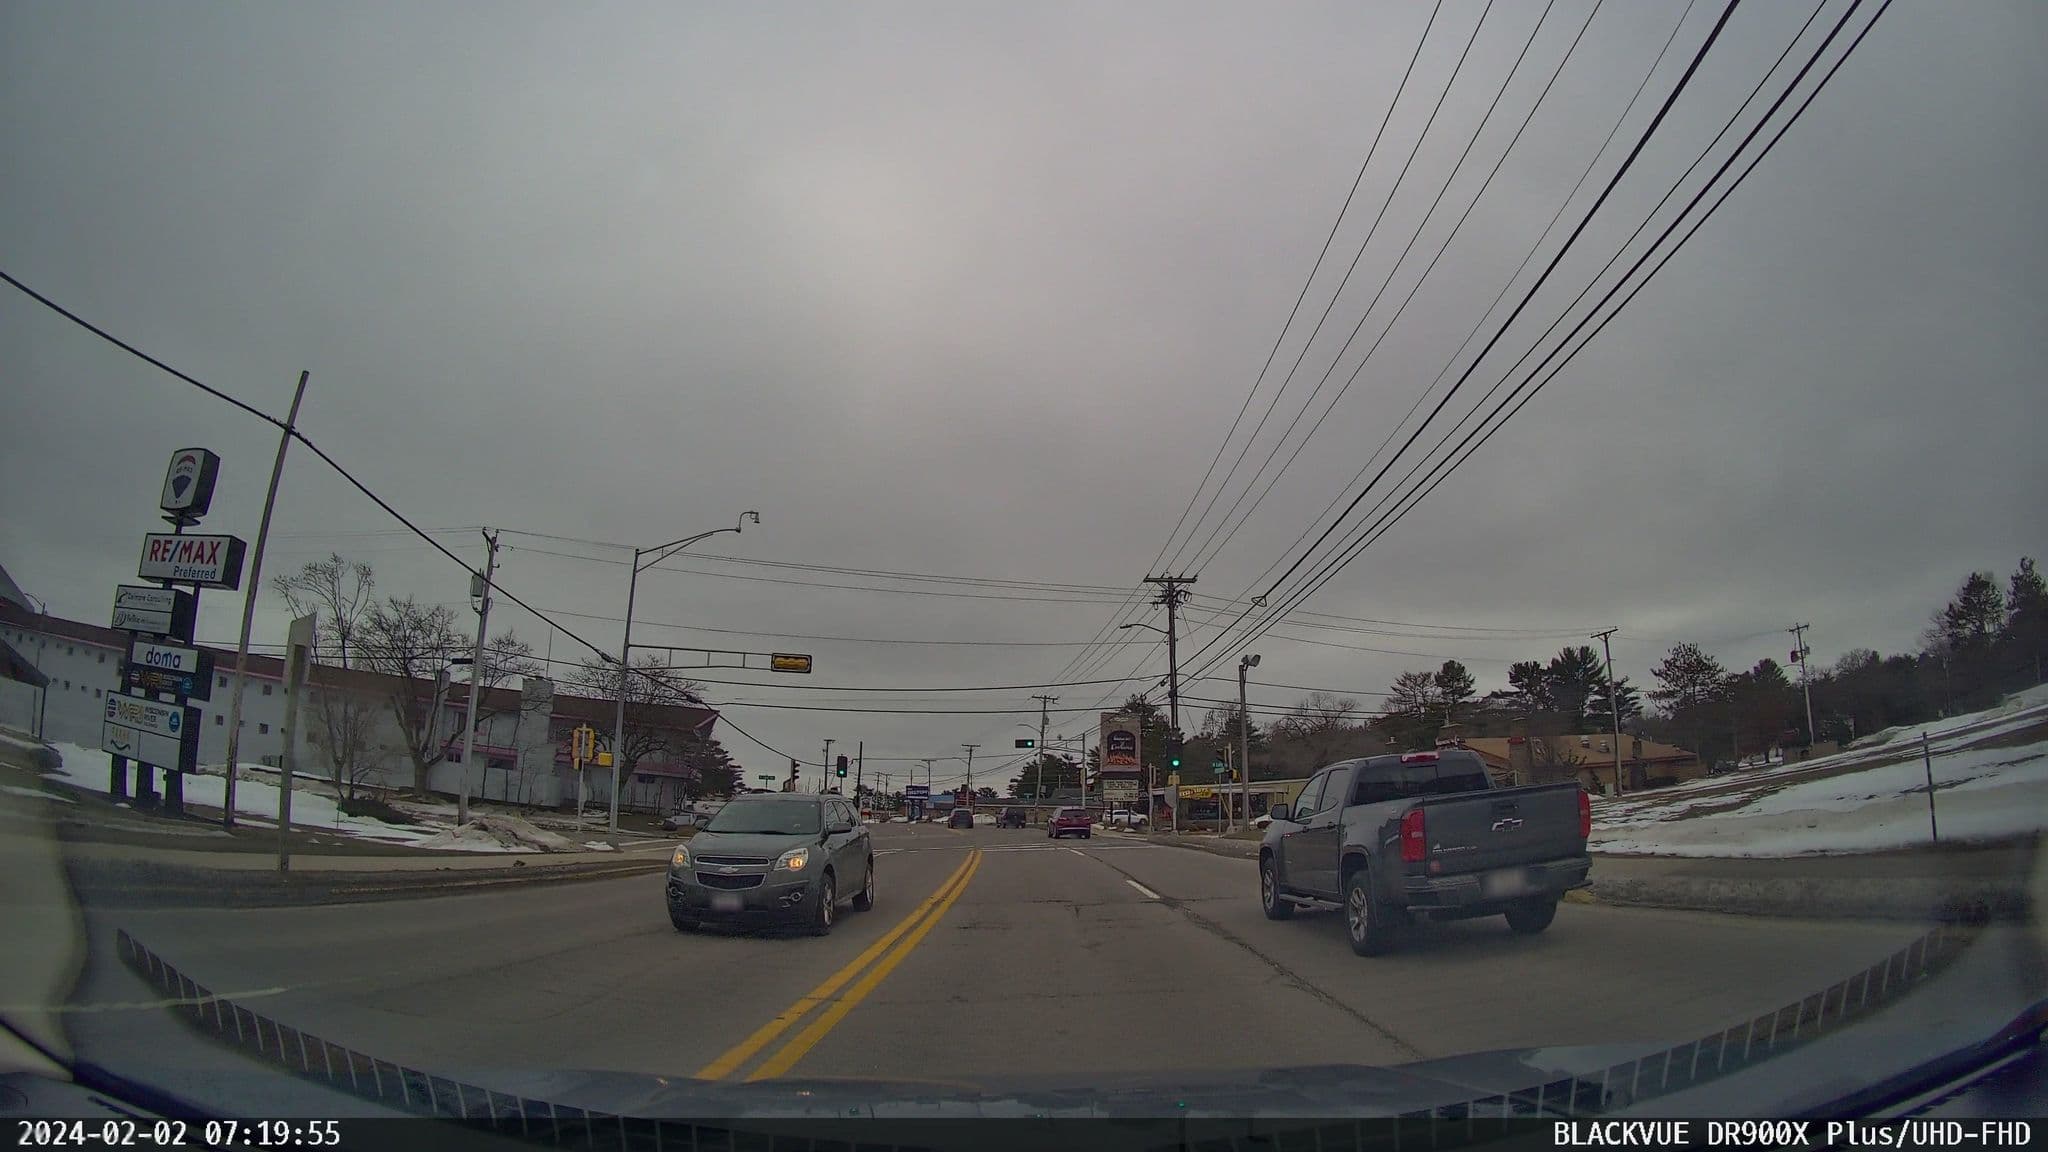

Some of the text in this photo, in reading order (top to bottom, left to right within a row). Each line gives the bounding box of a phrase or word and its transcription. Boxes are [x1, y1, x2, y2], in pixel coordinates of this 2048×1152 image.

[149, 539, 222, 566] RE/MAX
[173, 565, 217, 581] Preferred
[145, 646, 181, 669] doma
